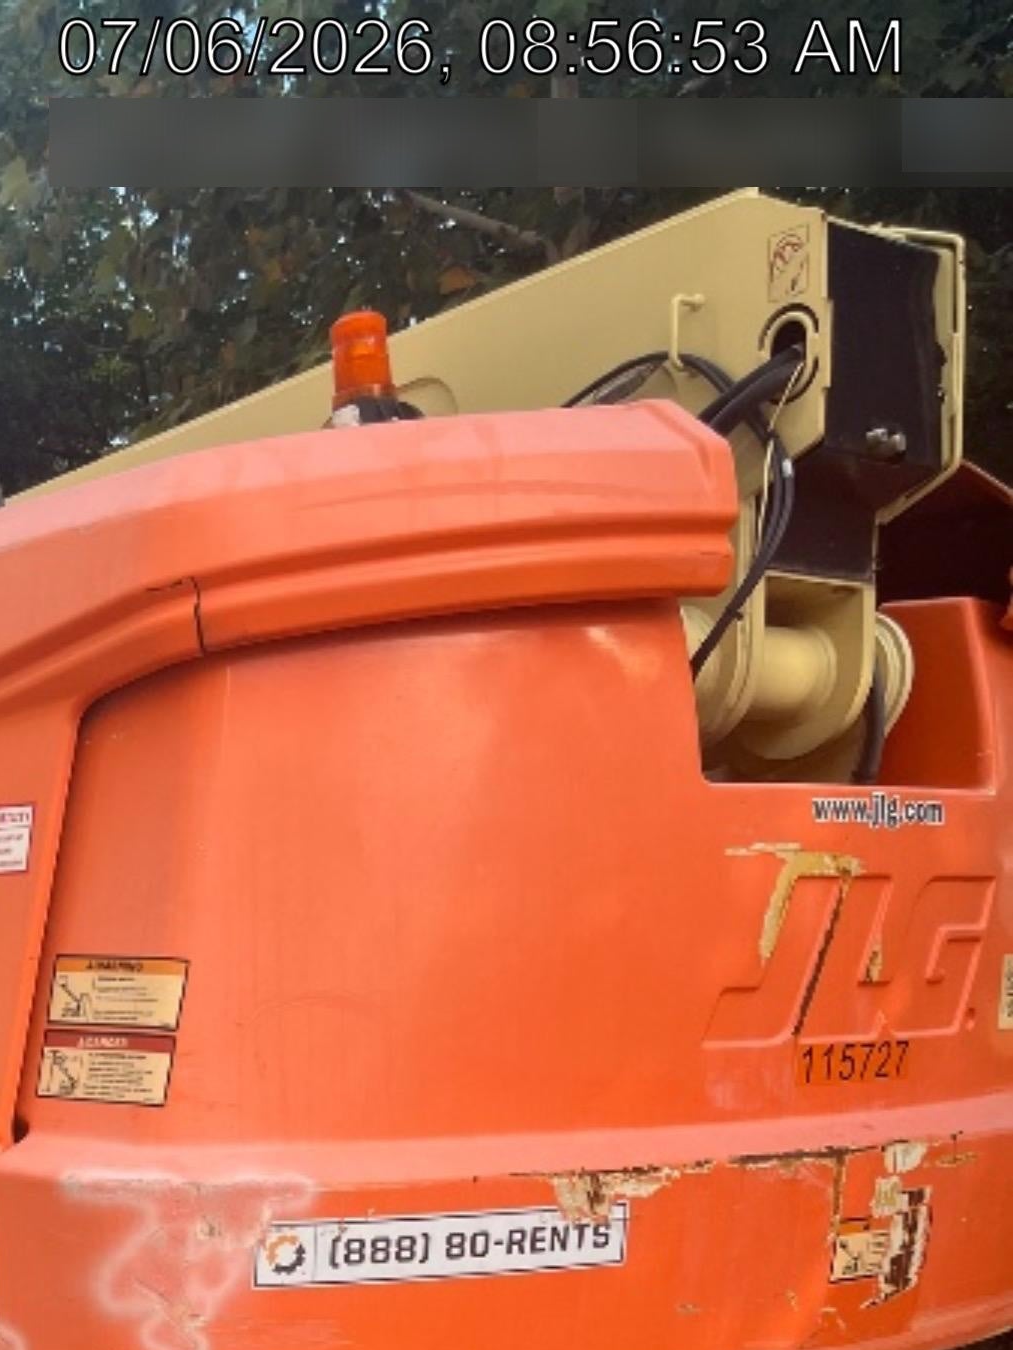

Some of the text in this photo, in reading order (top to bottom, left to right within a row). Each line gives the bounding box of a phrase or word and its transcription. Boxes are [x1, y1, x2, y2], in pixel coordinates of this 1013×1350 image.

[812, 793, 944, 827] www.jlg.com
[701, 874, 995, 1047] JLG
[802, 1041, 910, 1084] 115727
[329, 1223, 610, 1269] (888) 80-RENTS
